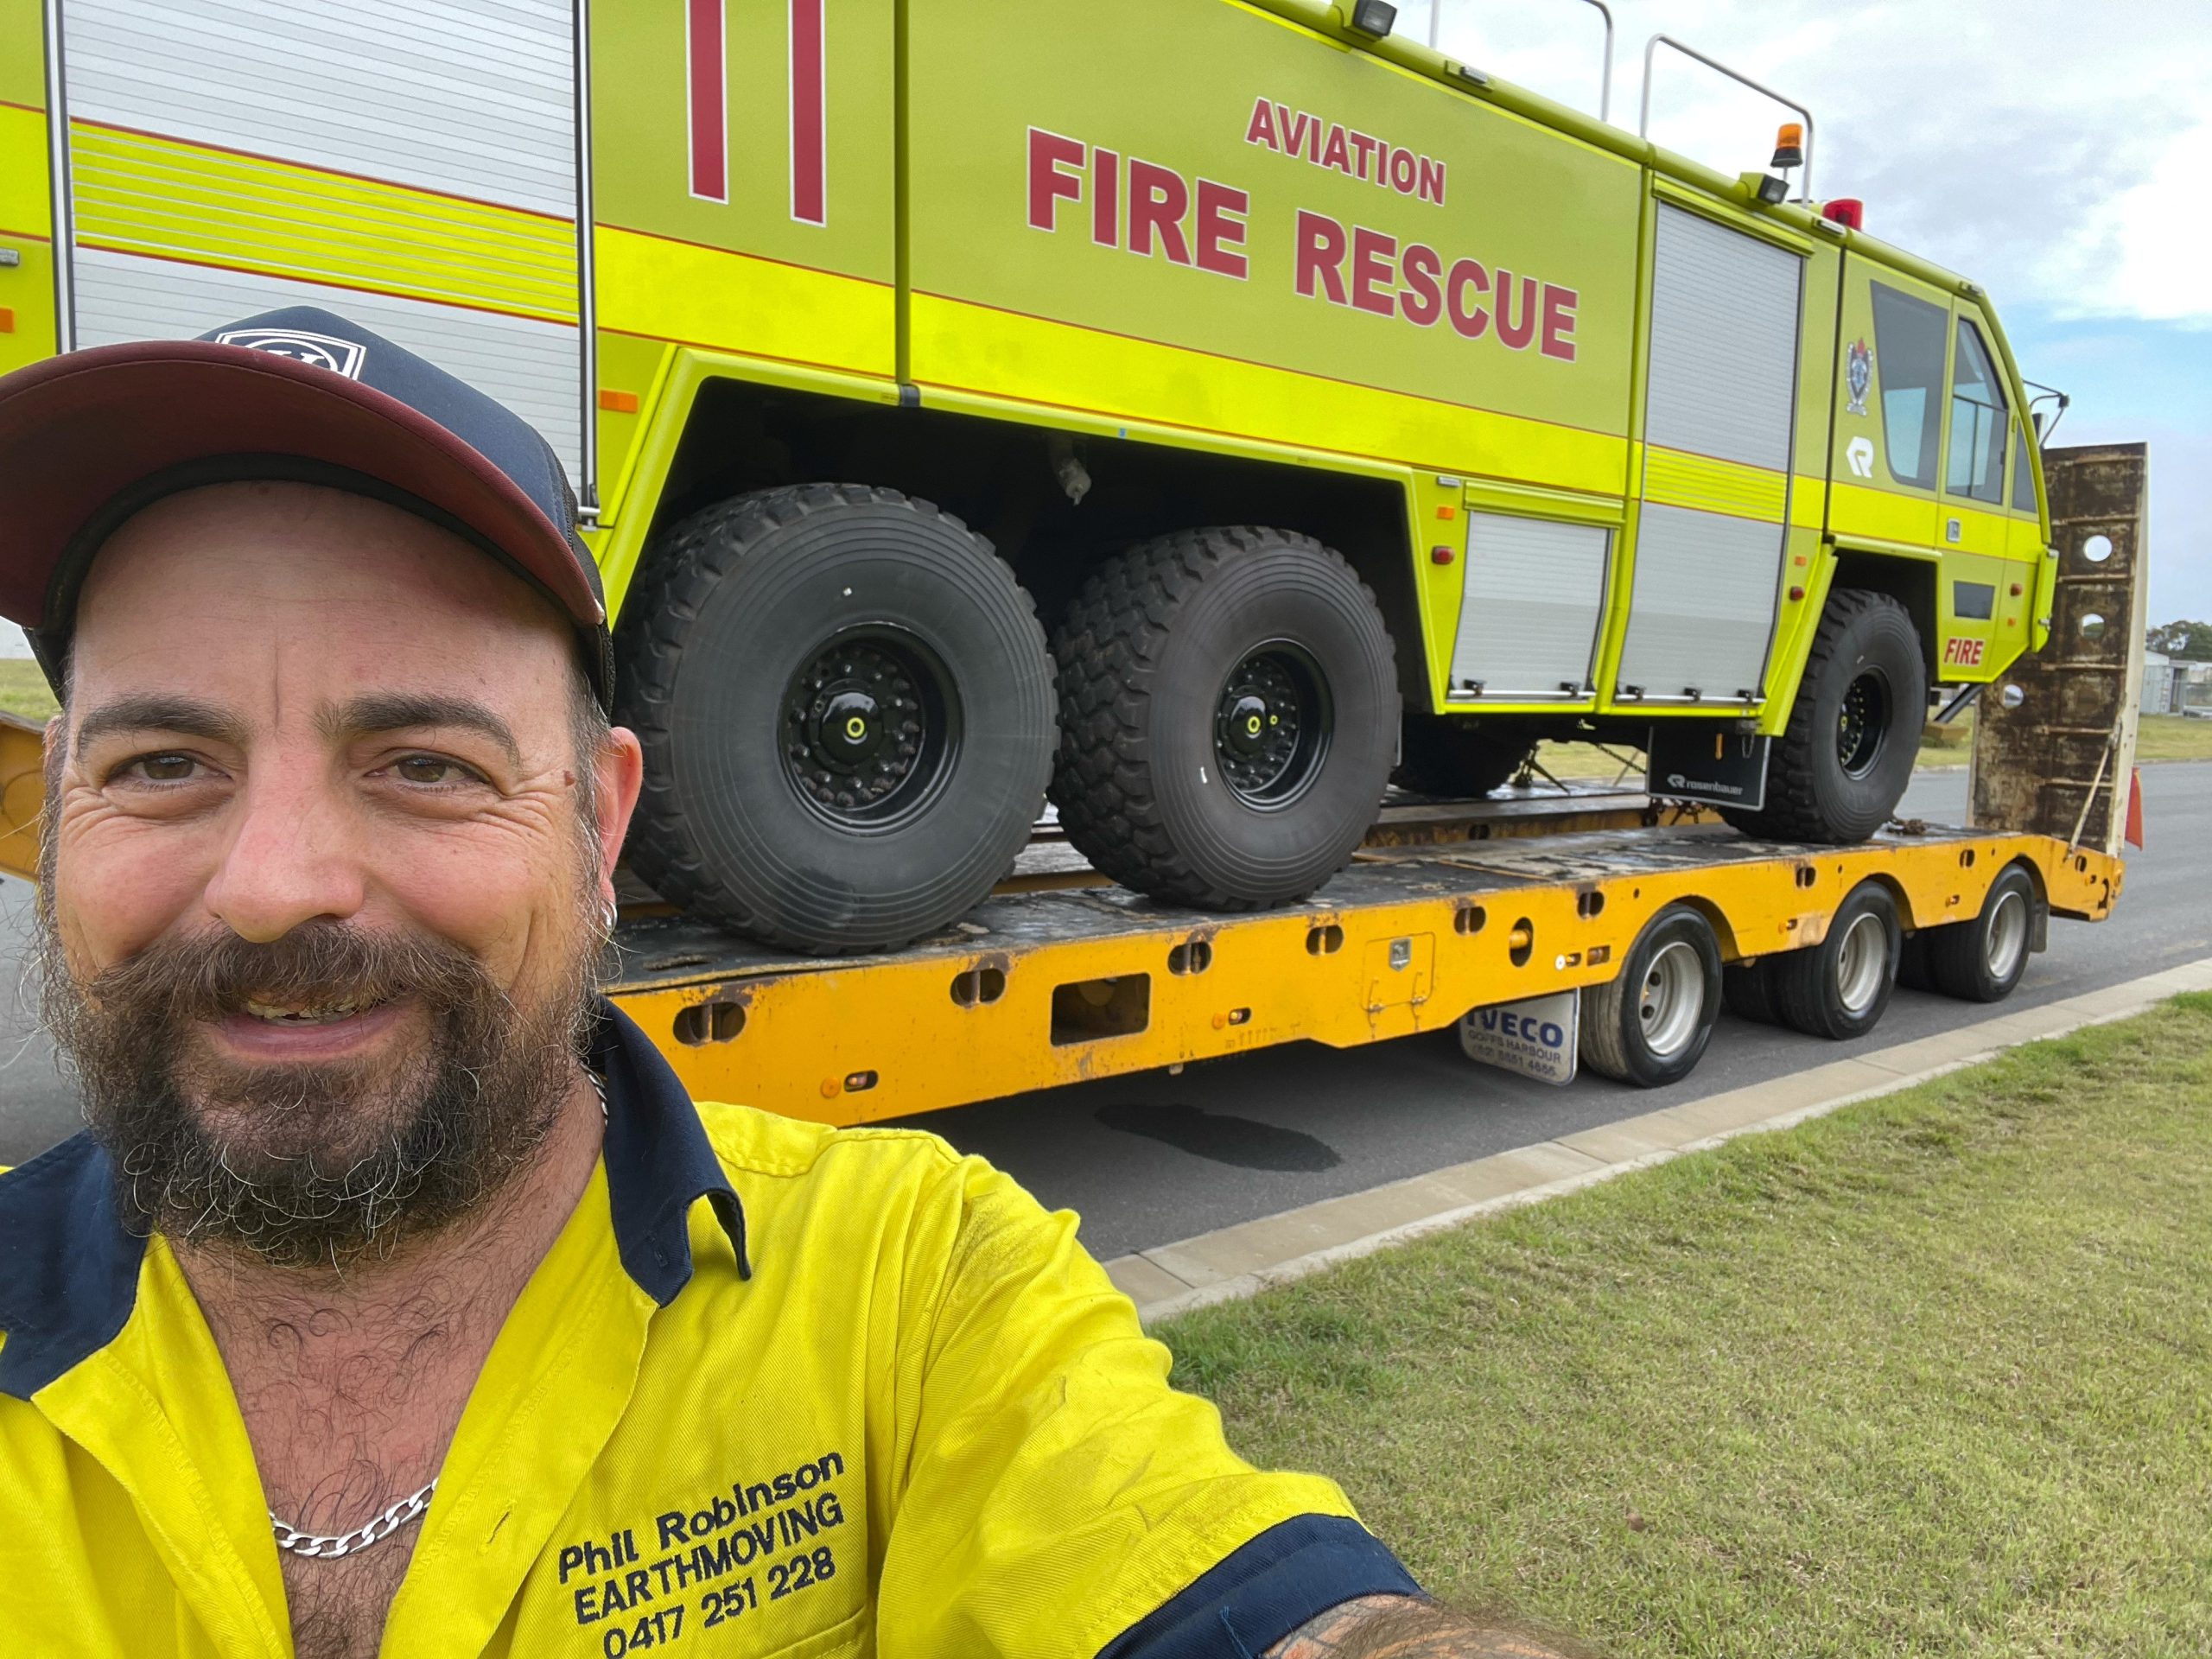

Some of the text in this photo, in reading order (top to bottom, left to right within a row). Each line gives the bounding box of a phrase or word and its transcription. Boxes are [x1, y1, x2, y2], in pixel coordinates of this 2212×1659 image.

[1245, 96, 1446, 207] AVIATION
[1027, 125, 1579, 363] FIRE RESCUE
[1943, 637, 1986, 666] FIRE
[1686, 780, 1743, 795] rosenbauer
[1466, 1008, 1563, 1049] IVECO
[1507, 1038, 1562, 1064] HARBOUR
[558, 1452, 844, 1585] Phil Robinson
[574, 1491, 844, 1625] EARTHMOVING
[602, 1546, 836, 1659] 0417 251 228
